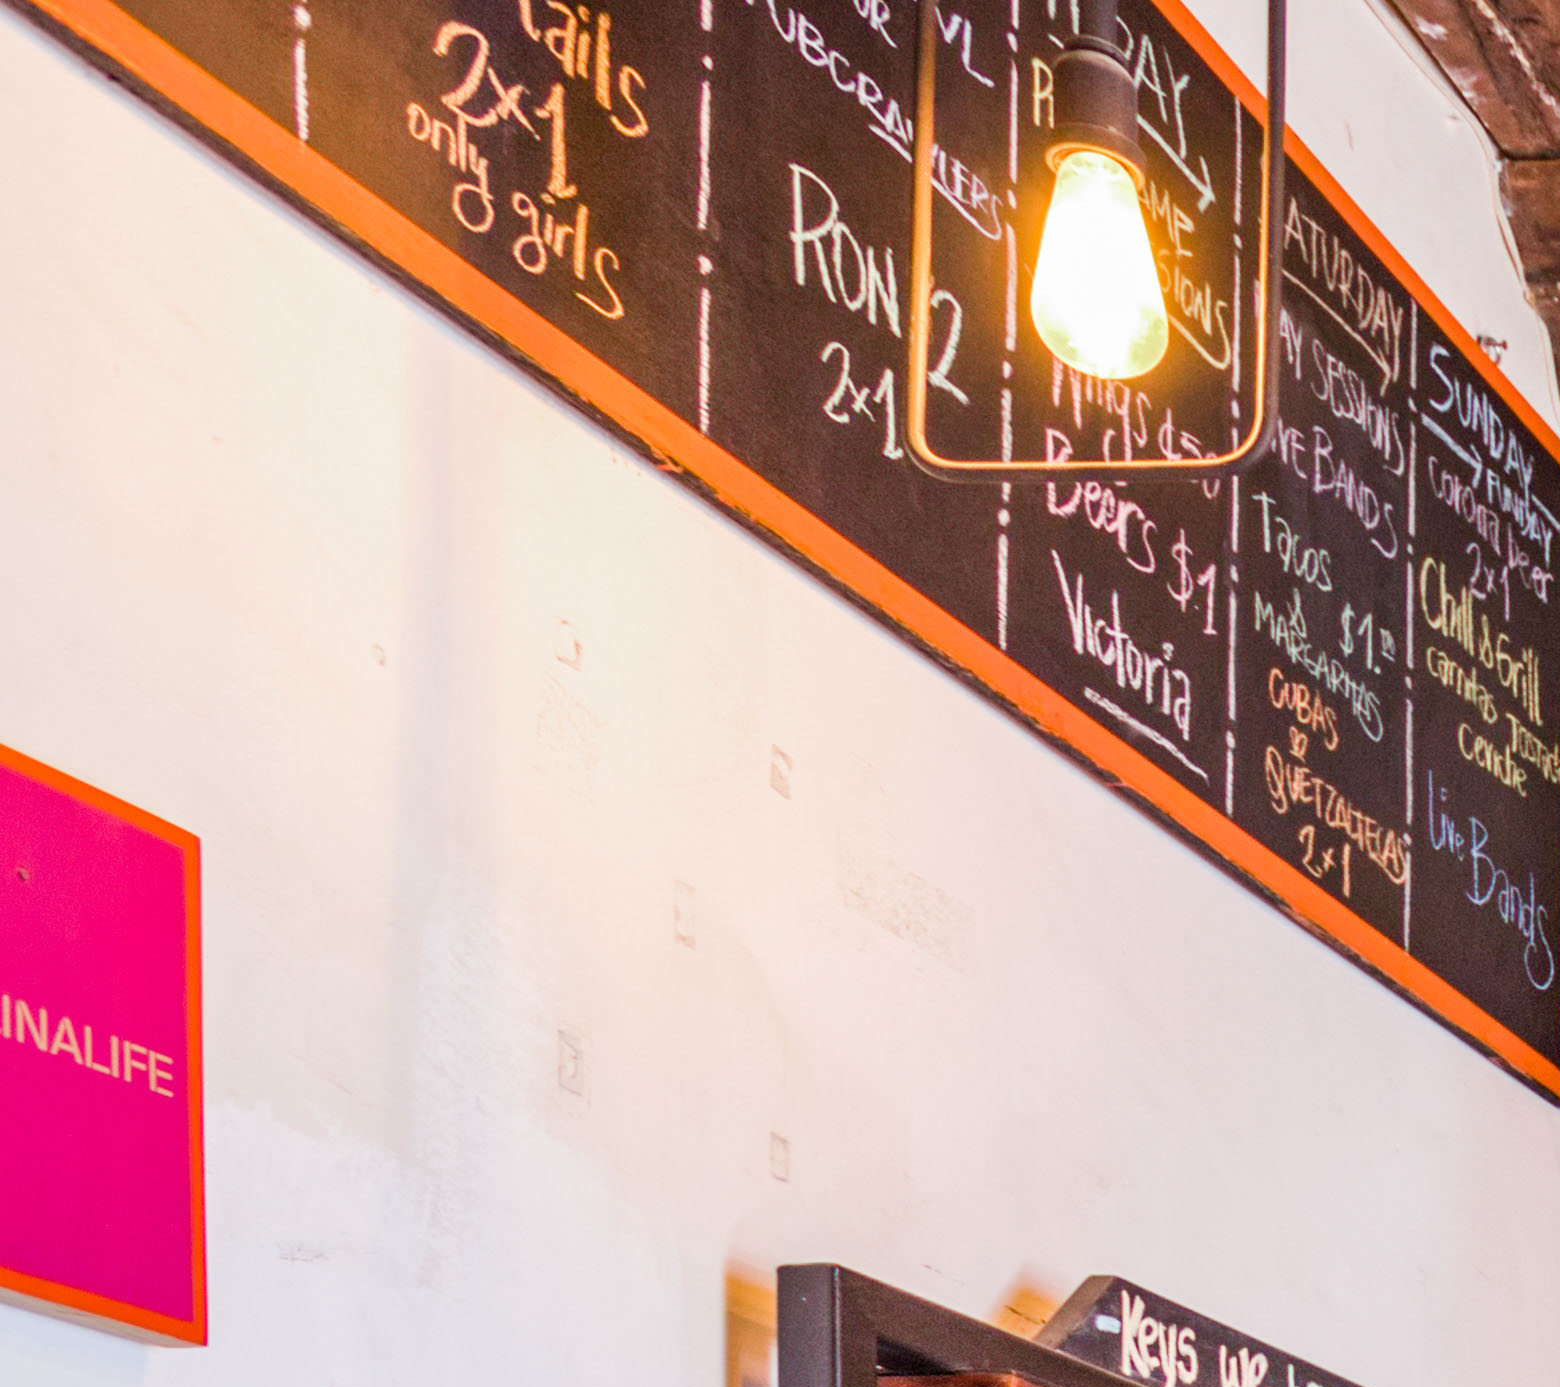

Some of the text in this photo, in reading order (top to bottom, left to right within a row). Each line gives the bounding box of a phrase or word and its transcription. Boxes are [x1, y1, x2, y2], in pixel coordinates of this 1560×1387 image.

[406, 102, 495, 233] only
[433, 21, 578, 199] 2x1
[511, 192, 625, 320] girls
[821, 342, 904, 460] 2x1
[1252, 491, 1333, 592] Tacos
[1313, 425, 1398, 559] BANDS
[1051, 548, 1192, 742] Victoria
[1268, 667, 1339, 752] CUBAS
[0, 994, 175, 1099] INALIFE
